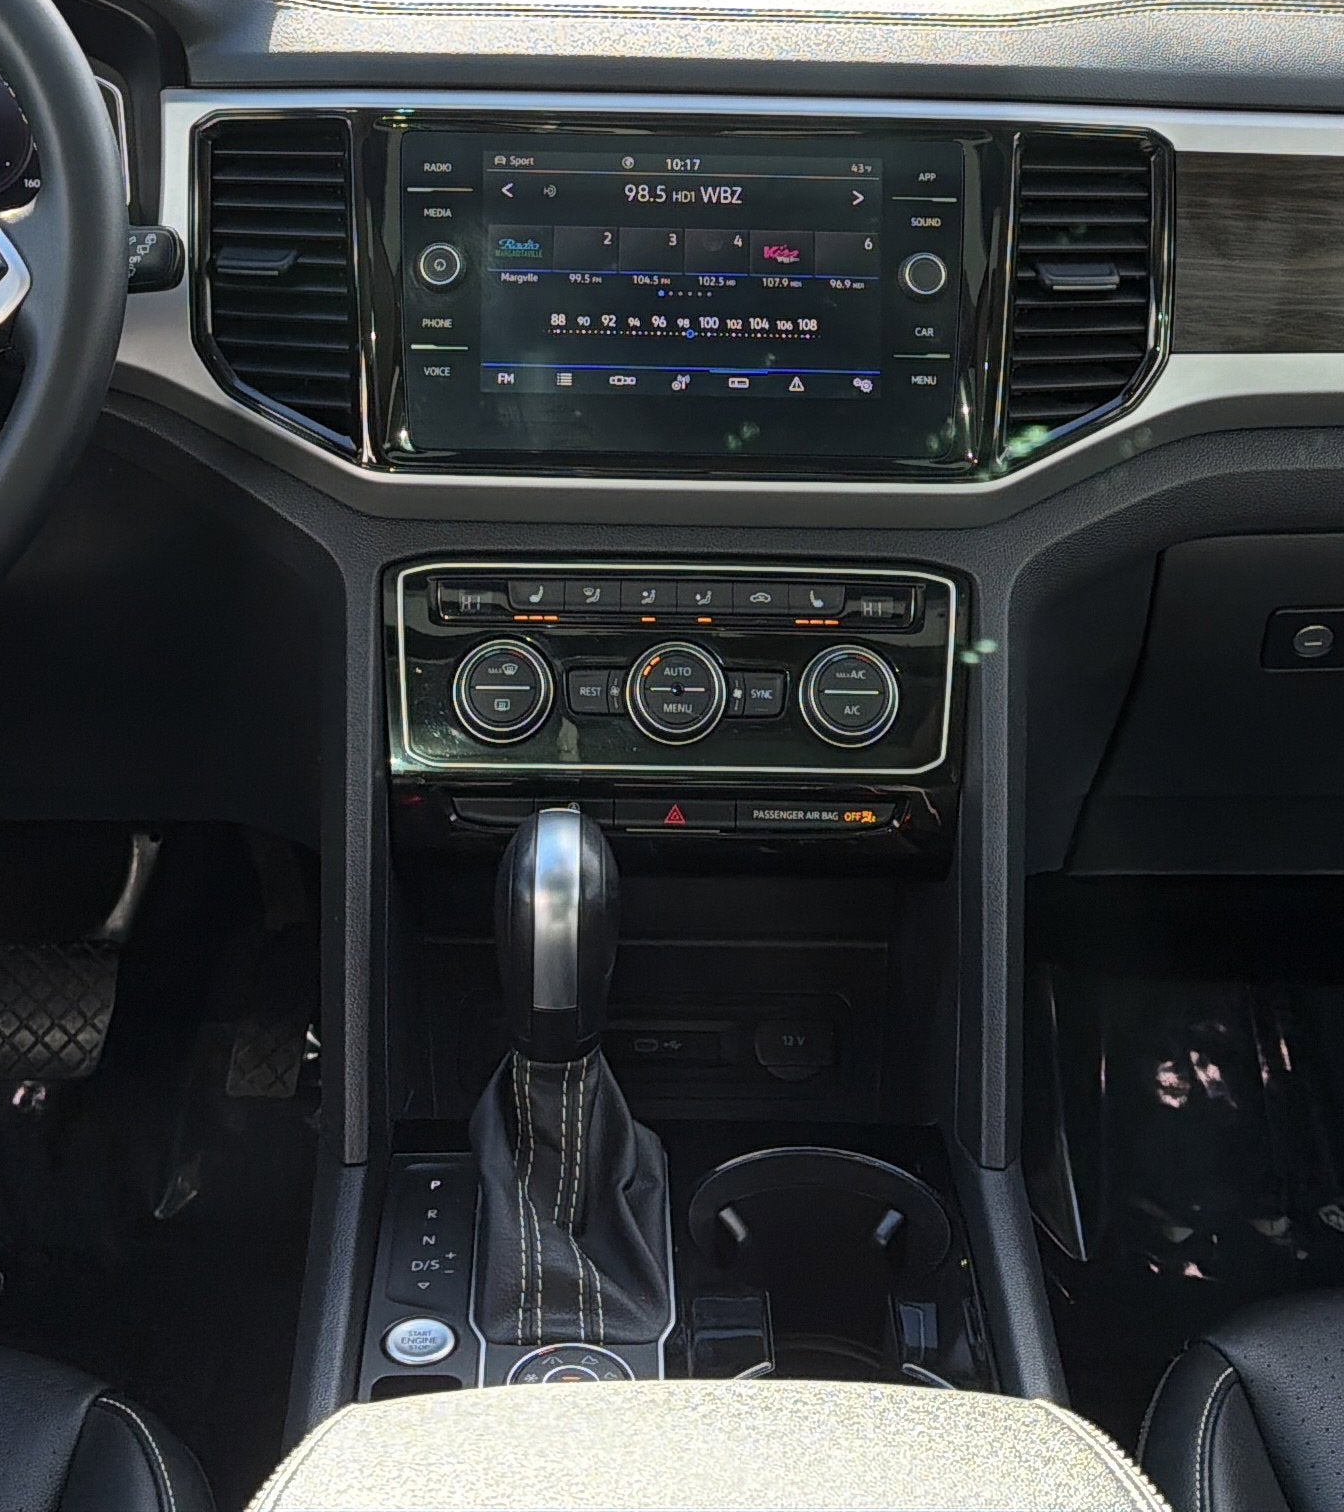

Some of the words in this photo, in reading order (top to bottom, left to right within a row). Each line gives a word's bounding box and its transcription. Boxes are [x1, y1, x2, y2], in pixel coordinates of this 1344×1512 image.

[509, 155, 534, 167] Sport
[665, 158, 701, 171] 10:17
[424, 163, 452, 172] RADIO
[918, 172, 936, 182] APP
[24, 178, 41, 188] 160
[624, 184, 667, 203] 98.5
[672, 190, 696, 203] HD1
[700, 186, 743, 204] WBZ
[424, 208, 452, 218] MEDIA
[910, 217, 942, 227] SOUND
[603, 232, 612, 245] 2
[668, 234, 677, 246] 3
[733, 235, 743, 247] 4
[864, 238, 873, 250] 6
[569, 274, 590, 284] 99.5
[633, 275, 659, 286] 104.5
[698, 276, 724, 286] 102.5
[762, 278, 788, 288] 107.9
[830, 279, 851, 289] 96.9
[422, 318, 453, 328] PHONE
[551, 314, 566, 326] 88
[577, 316, 591, 326] 90
[601, 315, 617, 327] 92
[628, 317, 641, 327] 94
[652, 316, 667, 328] 96
[677, 318, 690, 329] 98
[699, 316, 719, 329] 100
[726, 319, 743, 330] 102
[749, 317, 769, 330] 104
[777, 320, 793, 330] 106
[797, 318, 817, 331] 108
[915, 327, 934, 338] CAR
[423, 367, 451, 377] VOICE
[497, 373, 515, 385] FM
[911, 375, 937, 386] MENU
[862, 601, 882, 616] HI
[663, 666, 692, 677] AUTO
[851, 669, 866, 680] A/C
[580, 687, 601, 696] REST
[751, 689, 773, 700] SYNC
[663, 703, 692, 713] MENU
[844, 705, 860, 715] A/C
[753, 810, 804, 820] PASSENGER
[806, 811, 820, 820] AIR
[822, 812, 838, 821] BAG
[844, 812, 862, 822] OFF
[430, 1180, 441, 1190] P
[427, 1209, 438, 1219] R
[422, 1235, 436, 1245] N
[411, 1259, 441, 1272] D/S
[408, 1330, 432, 1338] START
[400, 1337, 438, 1345] ENGINE
